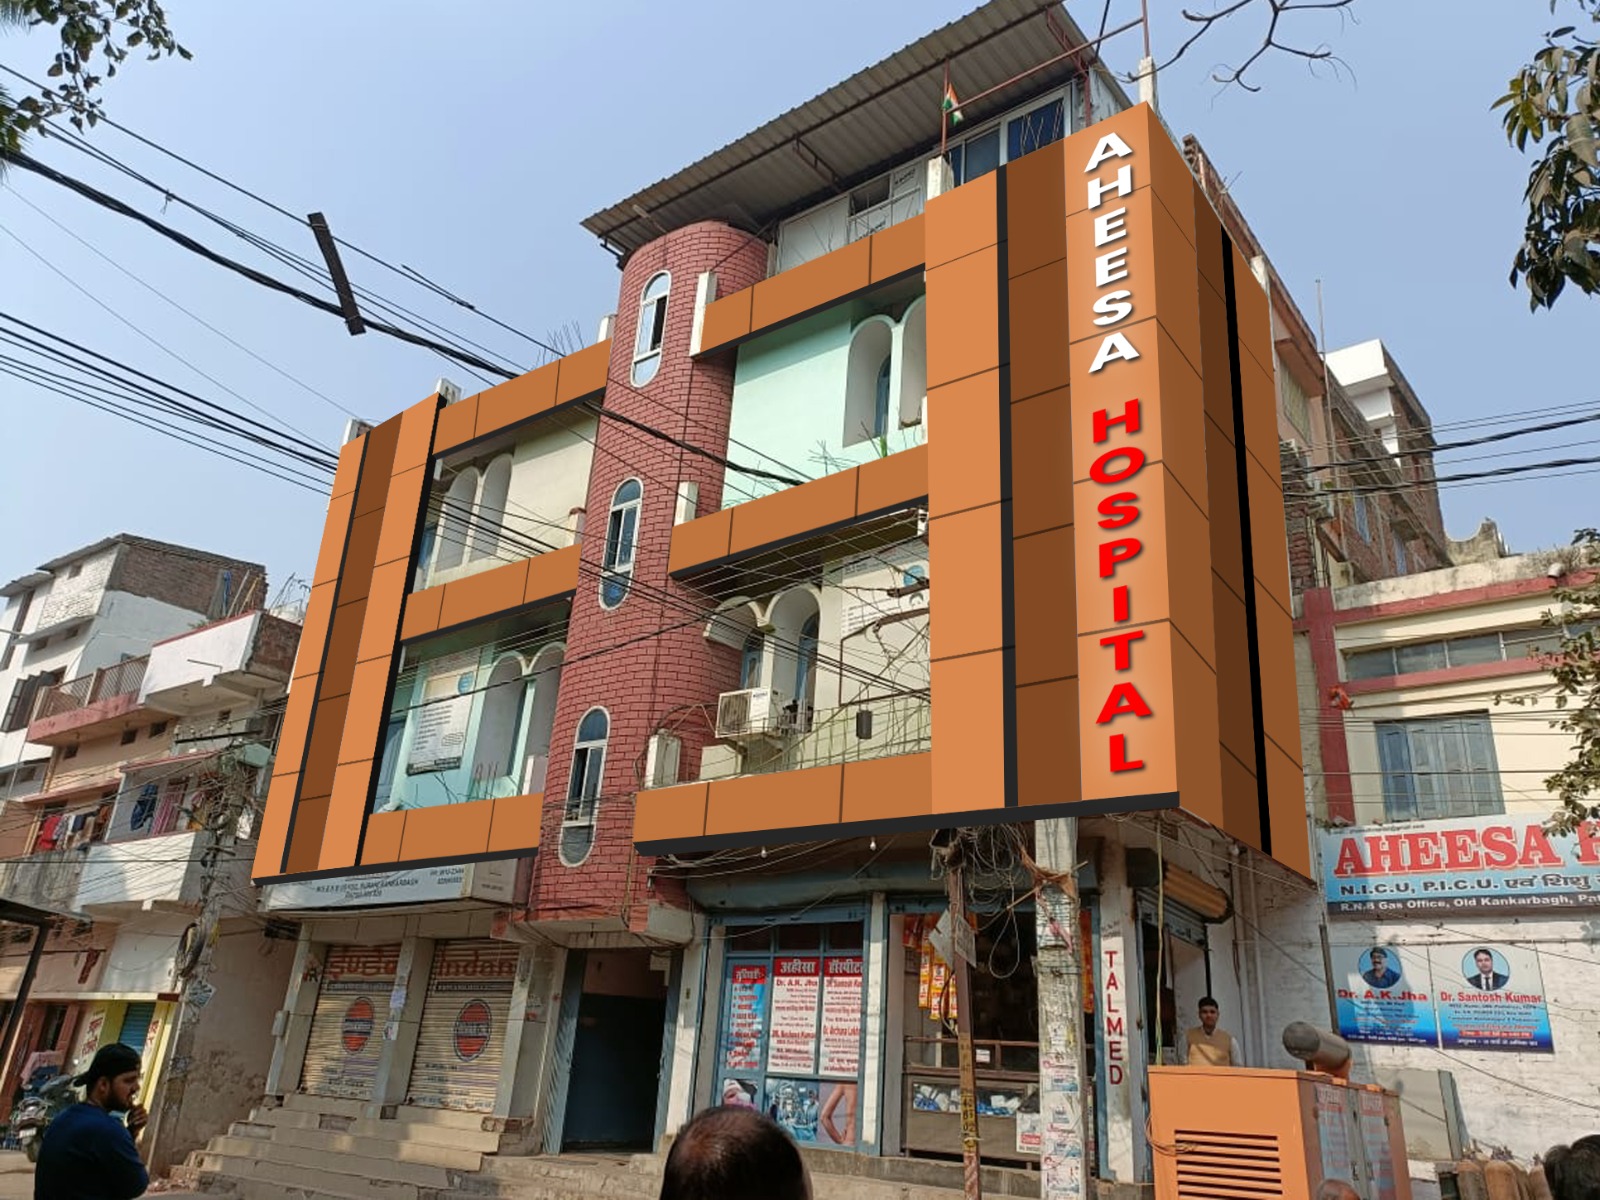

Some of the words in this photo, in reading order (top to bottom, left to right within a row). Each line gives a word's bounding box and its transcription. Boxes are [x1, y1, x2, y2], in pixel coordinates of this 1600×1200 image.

[1084, 132, 1139, 373] AHEESA
[1089, 398, 1151, 773] HOSPITAL
[1334, 824, 1564, 876] AHEESA
[1454, 898, 1477, 907] Old
[1481, 895, 1574, 906] Kankarbagh,
[1104, 950, 1123, 1085] TALMED
[1337, 989, 1358, 998] Dr.
[1440, 991, 1455, 1002] Dr.
[1457, 992, 1502, 1002] Santosh
[1505, 992, 1542, 1003] Kumar
